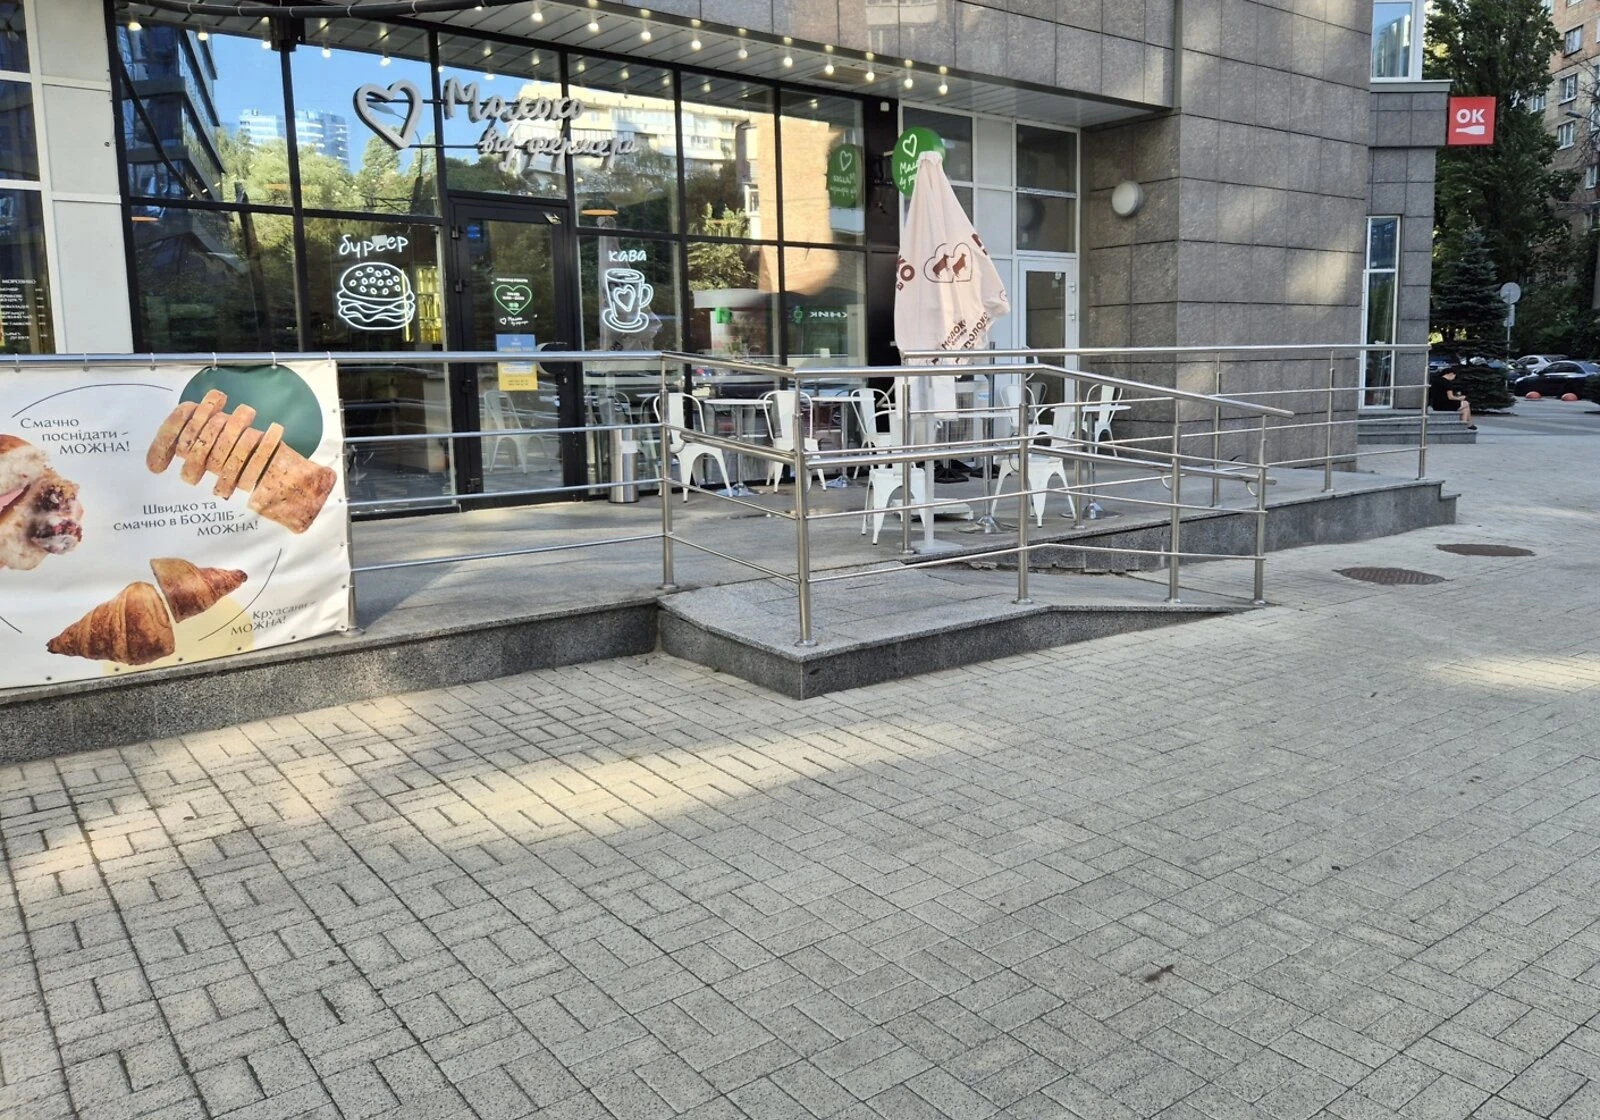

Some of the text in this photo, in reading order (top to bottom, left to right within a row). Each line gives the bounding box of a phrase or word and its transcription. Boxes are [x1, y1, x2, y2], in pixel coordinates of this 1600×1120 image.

[443, 76, 584, 123] Молоко
[526, 135, 639, 170] фермера
[608, 249, 647, 262] кава
[20, 417, 80, 429] Смачно
[42, 429, 118, 442] поснідати
[59, 440, 130, 455] МОЖНА!
[142, 501, 217, 515] Швидко та
[113, 517, 167, 531] смачно
[169, 517, 177, 526] в
[180, 510, 235, 525] БОХЛІБ
[196, 520, 259, 537] МОЖНА!
[231, 615, 287, 636] МОЖНА!
